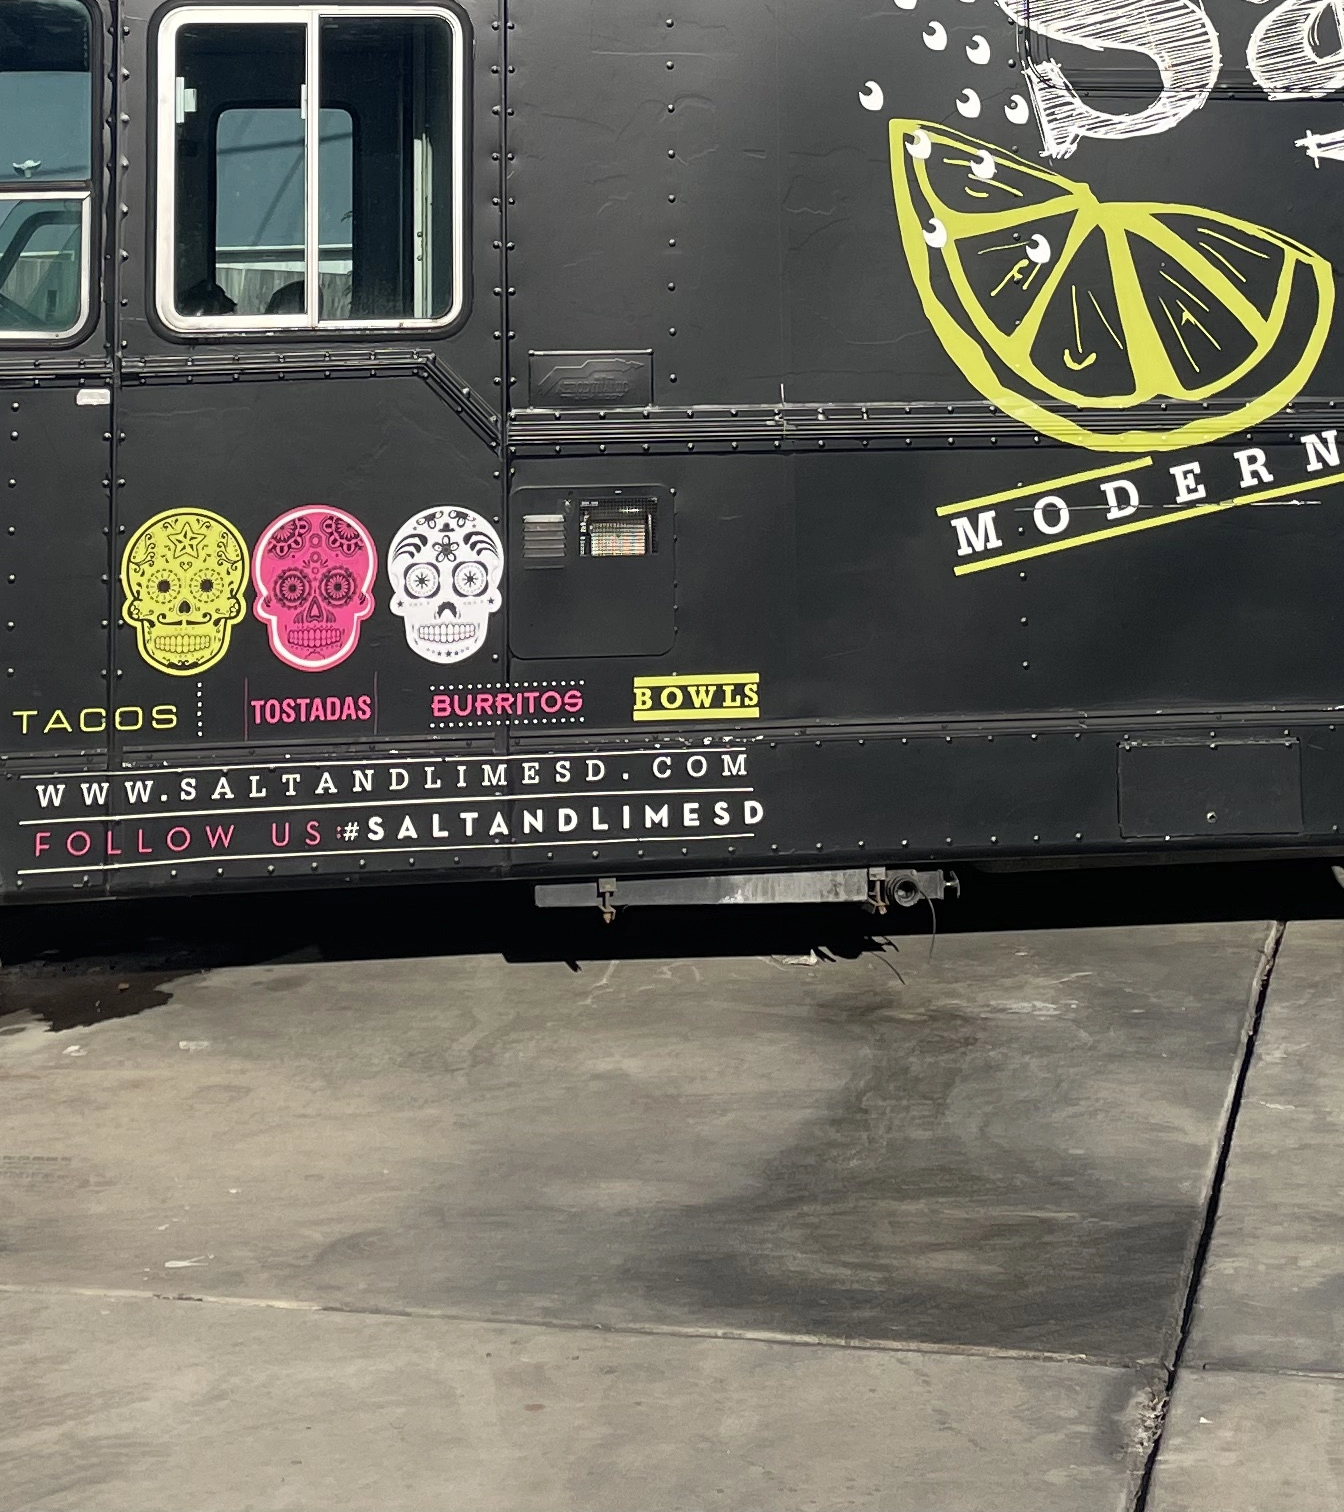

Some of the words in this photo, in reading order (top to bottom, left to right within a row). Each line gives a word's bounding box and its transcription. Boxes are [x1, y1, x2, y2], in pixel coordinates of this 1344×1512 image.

[951, 430, 1341, 556] MODERN
[251, 695, 372, 725] TOSTADAS
[431, 689, 584, 718] BURRITOS
[634, 681, 759, 711] BOWLS
[12, 705, 177, 734] TACOS
[35, 753, 748, 809] WWW.SALTANDLIMESD.COM
[35, 825, 235, 857] FOLLOW
[342, 800, 764, 842] #SALTANDLIMESD
